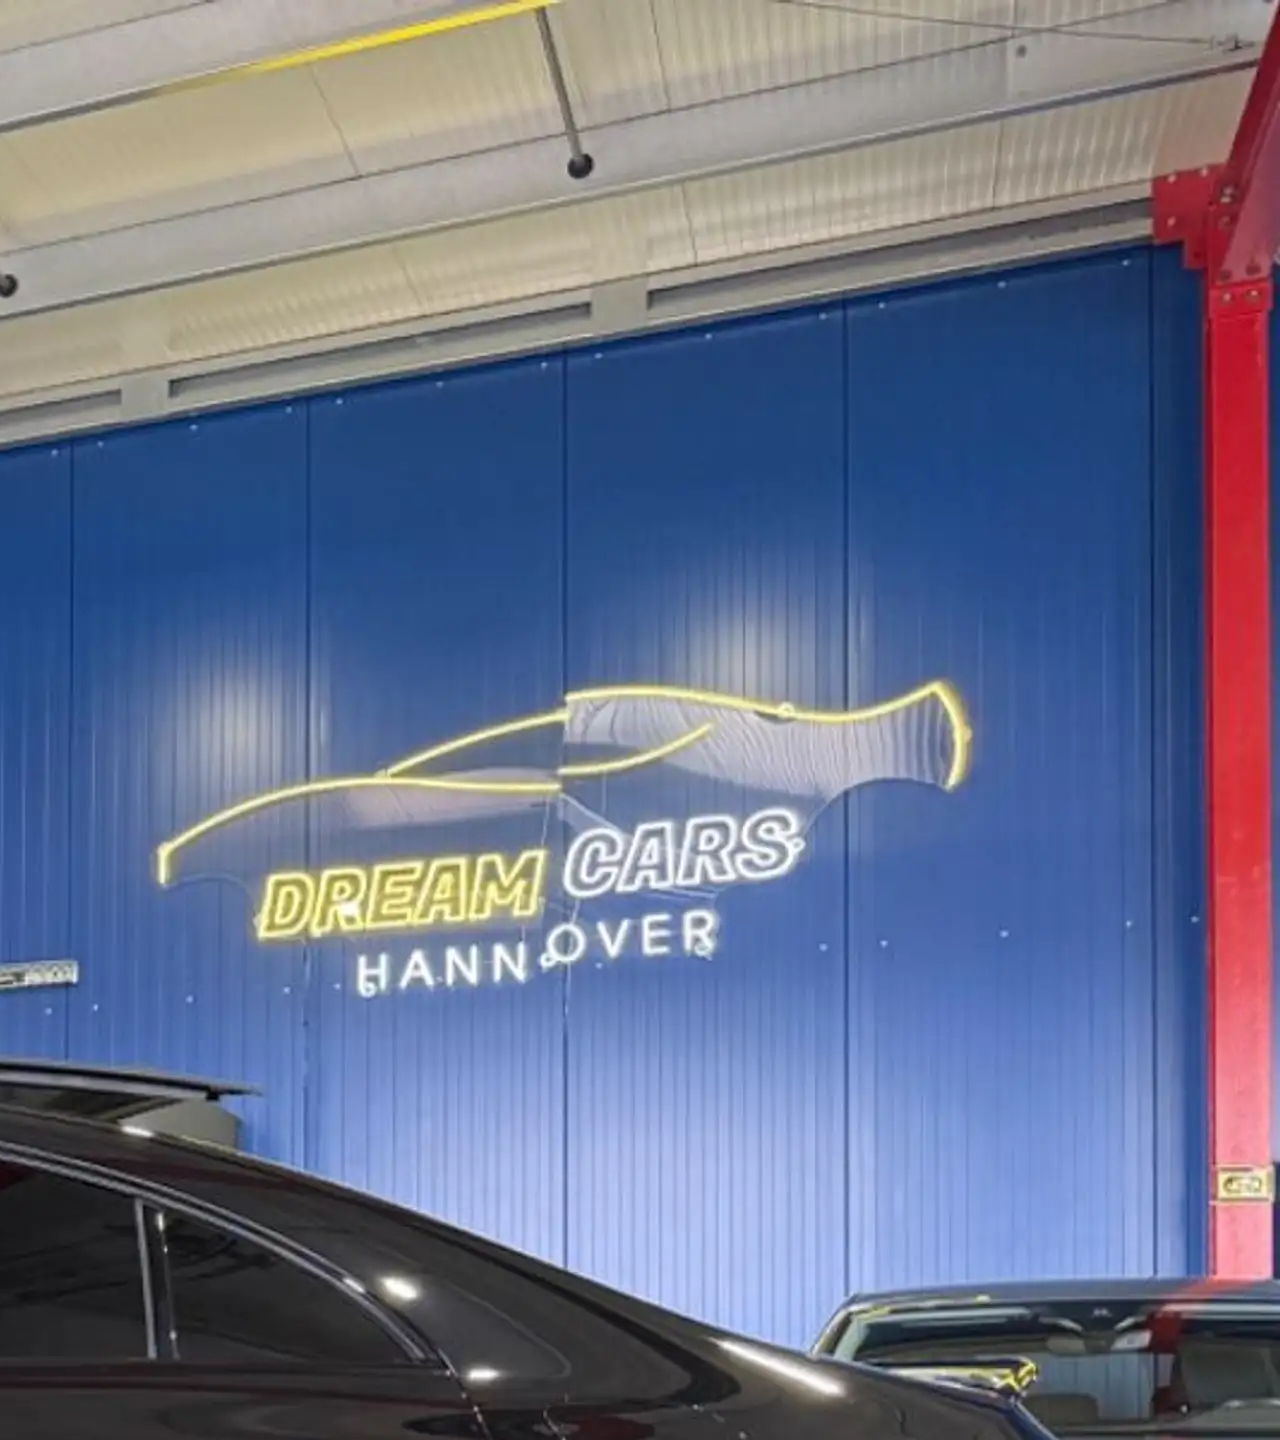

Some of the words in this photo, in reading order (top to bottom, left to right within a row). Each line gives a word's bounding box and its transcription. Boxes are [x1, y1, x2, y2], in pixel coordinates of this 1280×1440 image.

[254, 849, 547, 942] DREAM
[562, 807, 802, 899] CARS
[355, 909, 719, 998] HANNOVER
